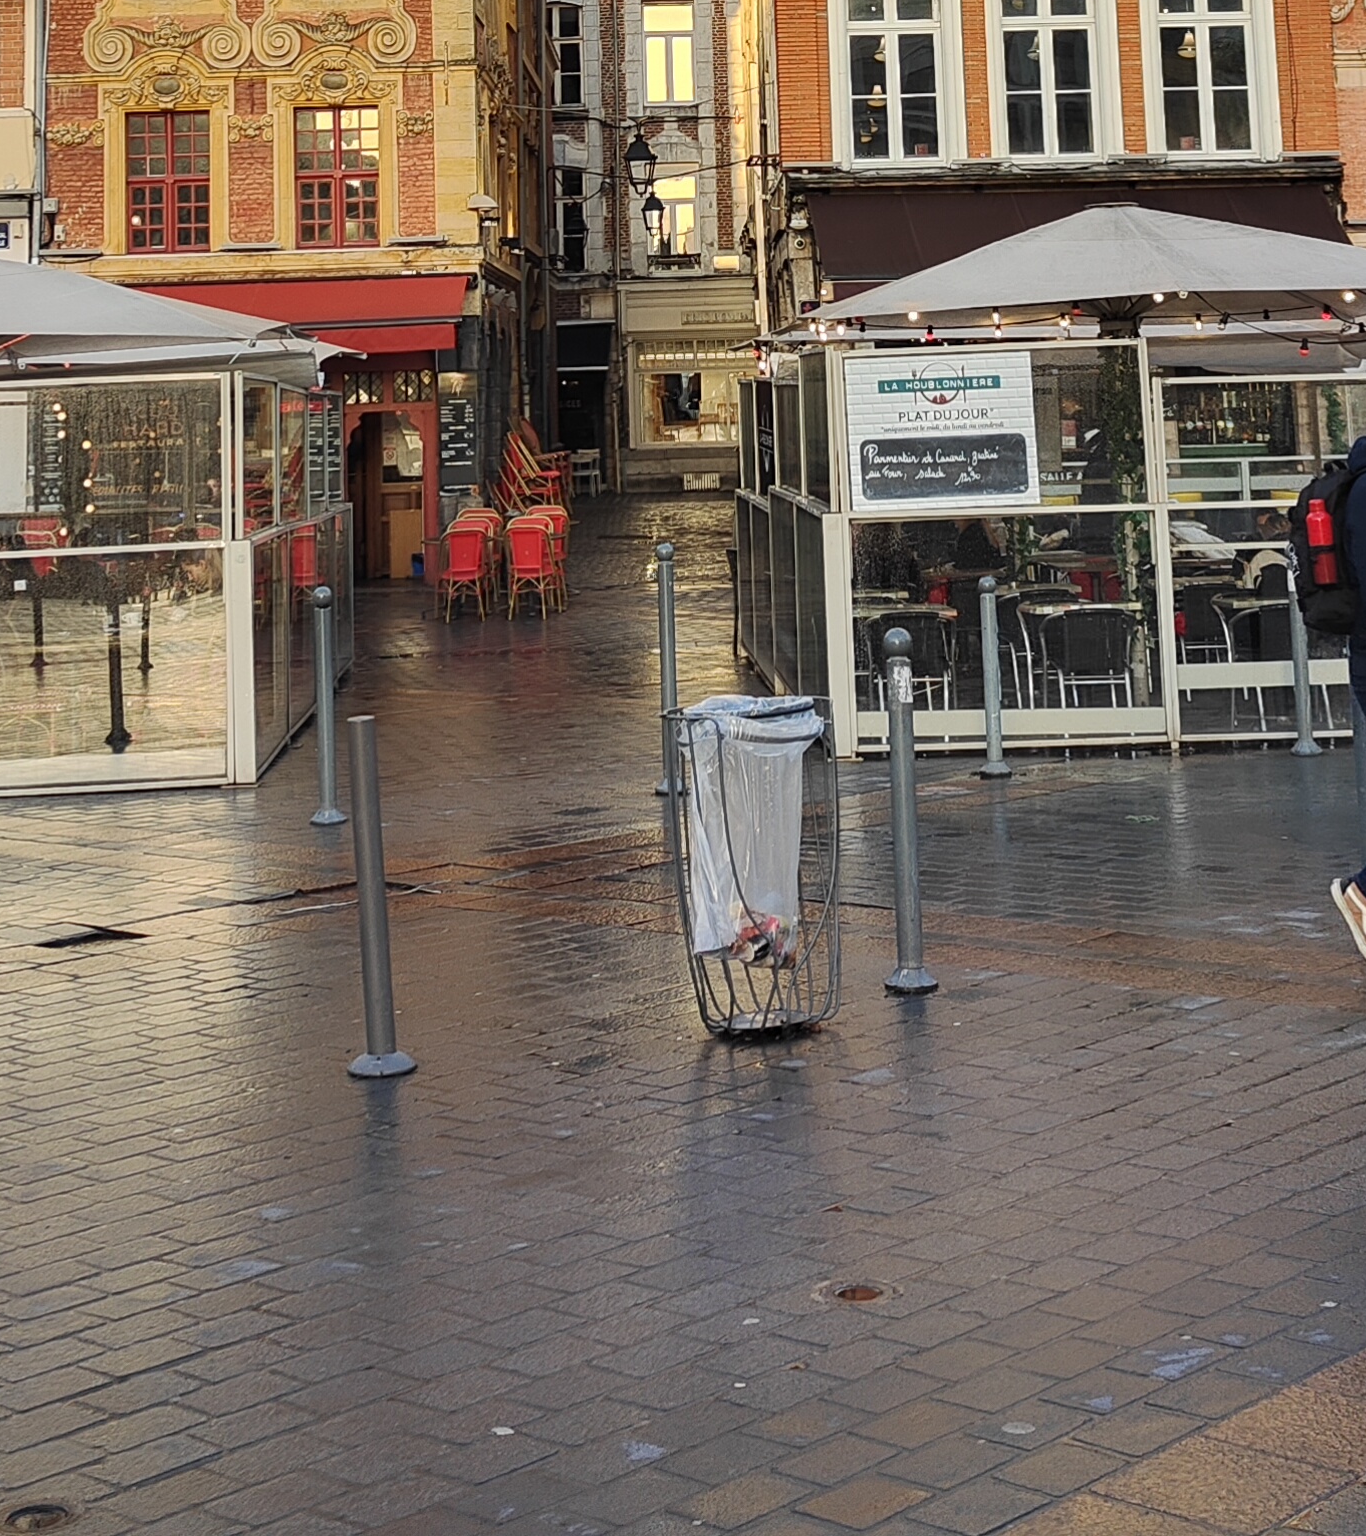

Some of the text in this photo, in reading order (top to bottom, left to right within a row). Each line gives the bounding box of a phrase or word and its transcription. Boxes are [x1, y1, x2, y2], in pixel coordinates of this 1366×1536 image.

[884, 378, 994, 391] LA HOUBLONNIERE
[898, 410, 930, 422] PLAT
[933, 410, 952, 420] DU
